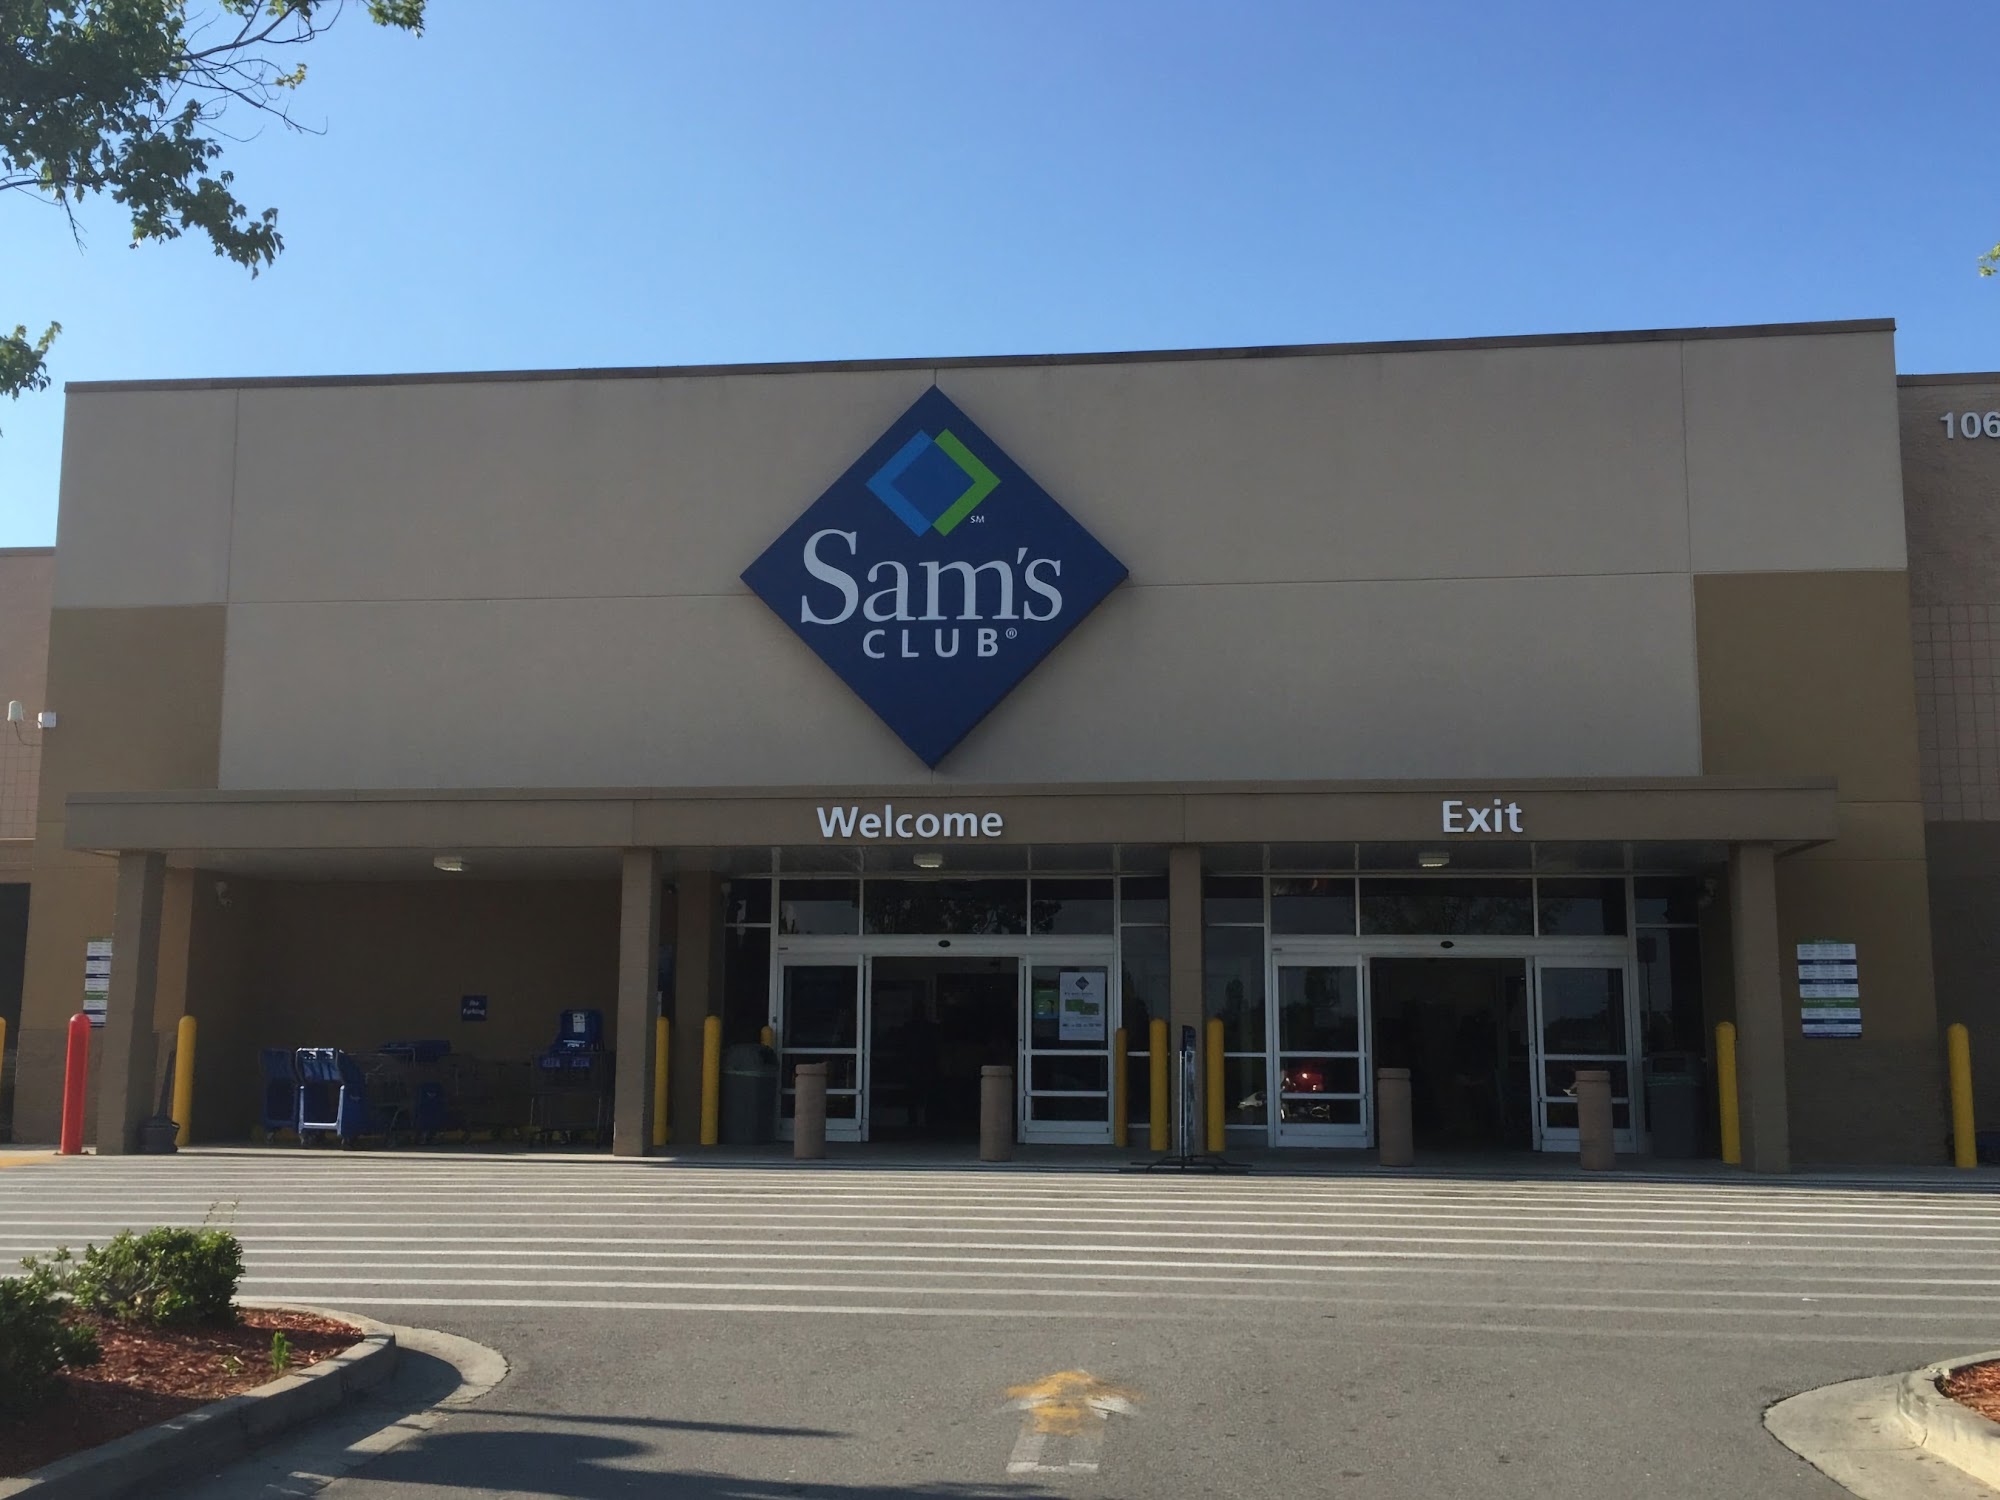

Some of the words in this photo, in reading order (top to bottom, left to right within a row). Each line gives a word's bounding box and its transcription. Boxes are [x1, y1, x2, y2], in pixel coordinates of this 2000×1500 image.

[801, 528, 1063, 625] Sam's
[816, 804, 1004, 838] Welcome
[1442, 798, 1524, 833] Exit
